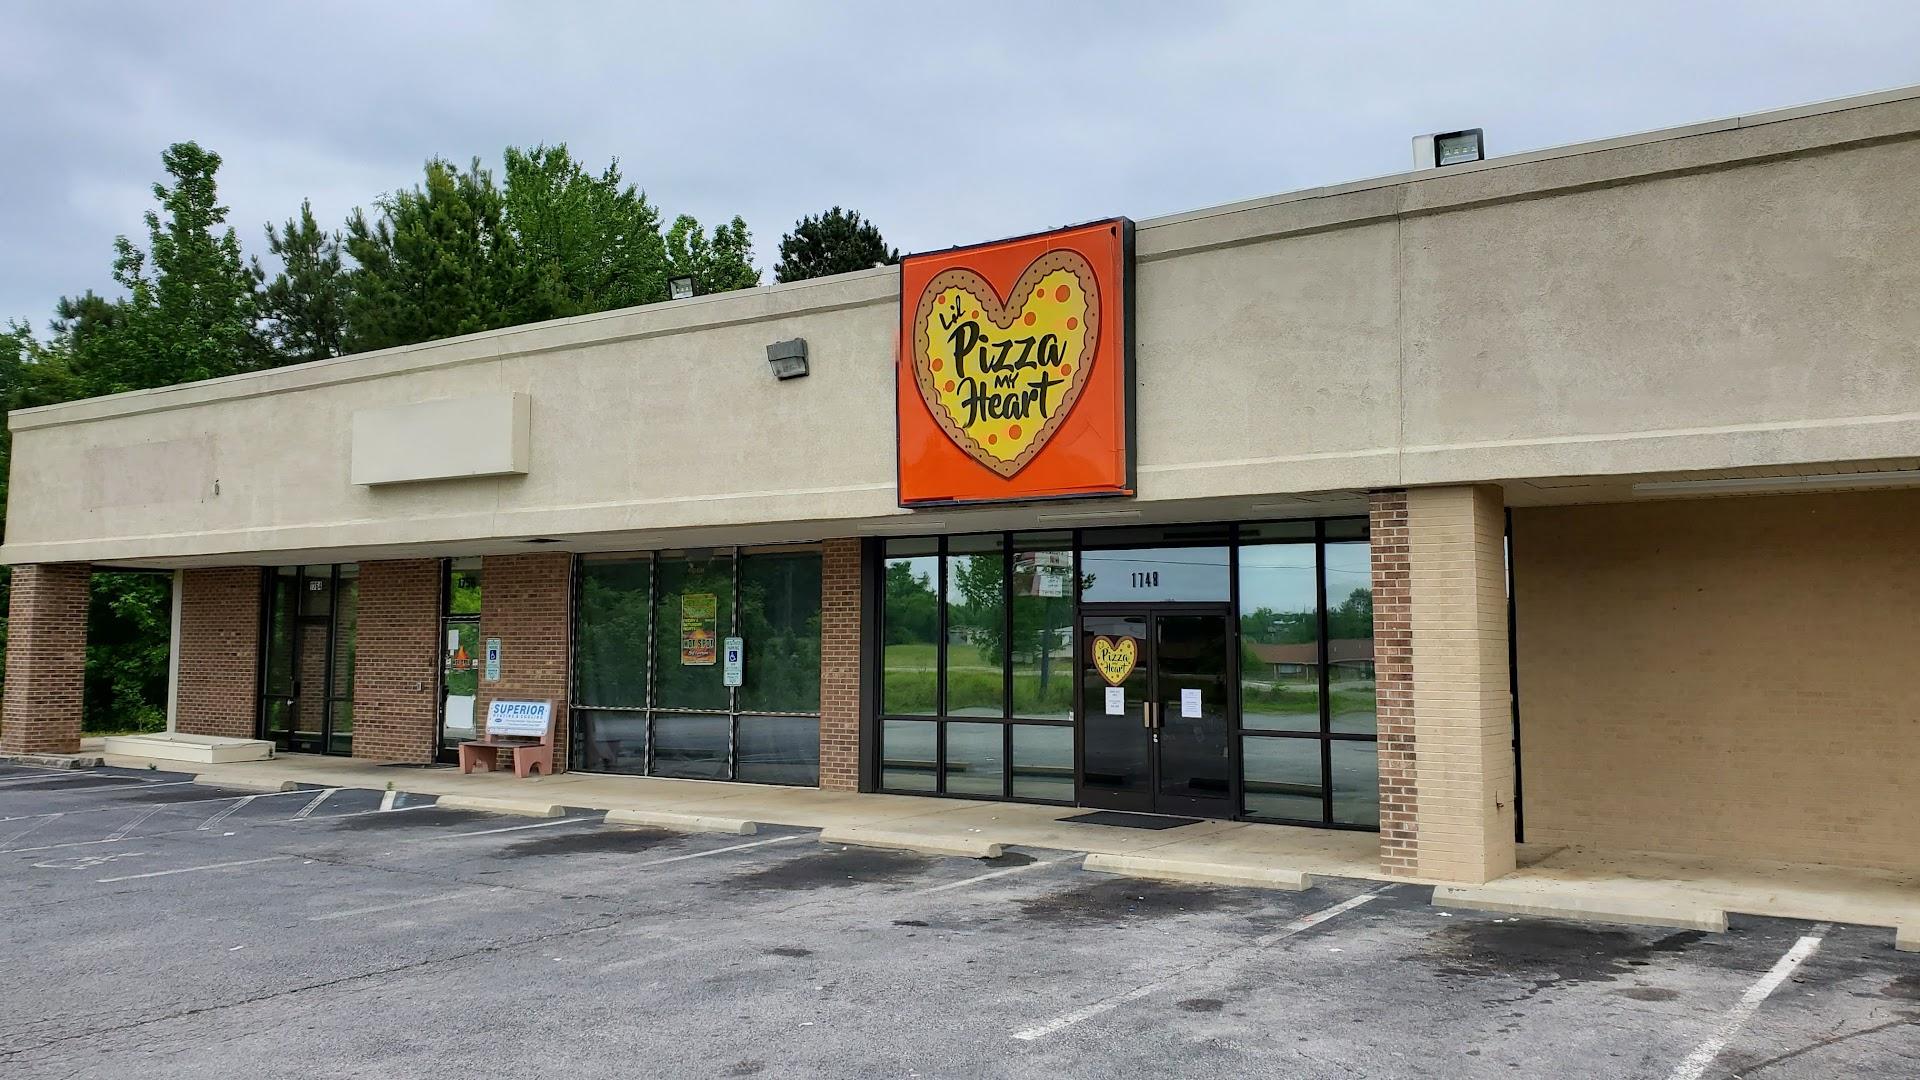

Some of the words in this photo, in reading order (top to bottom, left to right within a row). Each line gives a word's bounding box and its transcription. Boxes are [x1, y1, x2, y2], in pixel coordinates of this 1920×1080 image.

[947, 321, 1067, 378] Pizza
[994, 372, 1019, 388] MY
[957, 371, 1065, 429] Heart
[1131, 571, 1159, 588] 1748
[683, 639, 696, 649] HOT
[697, 638, 714, 648] SPOT
[1102, 648, 1129, 662] Pizza
[1104, 662, 1129, 674] Heart
[493, 703, 545, 716] SUPERIOR
